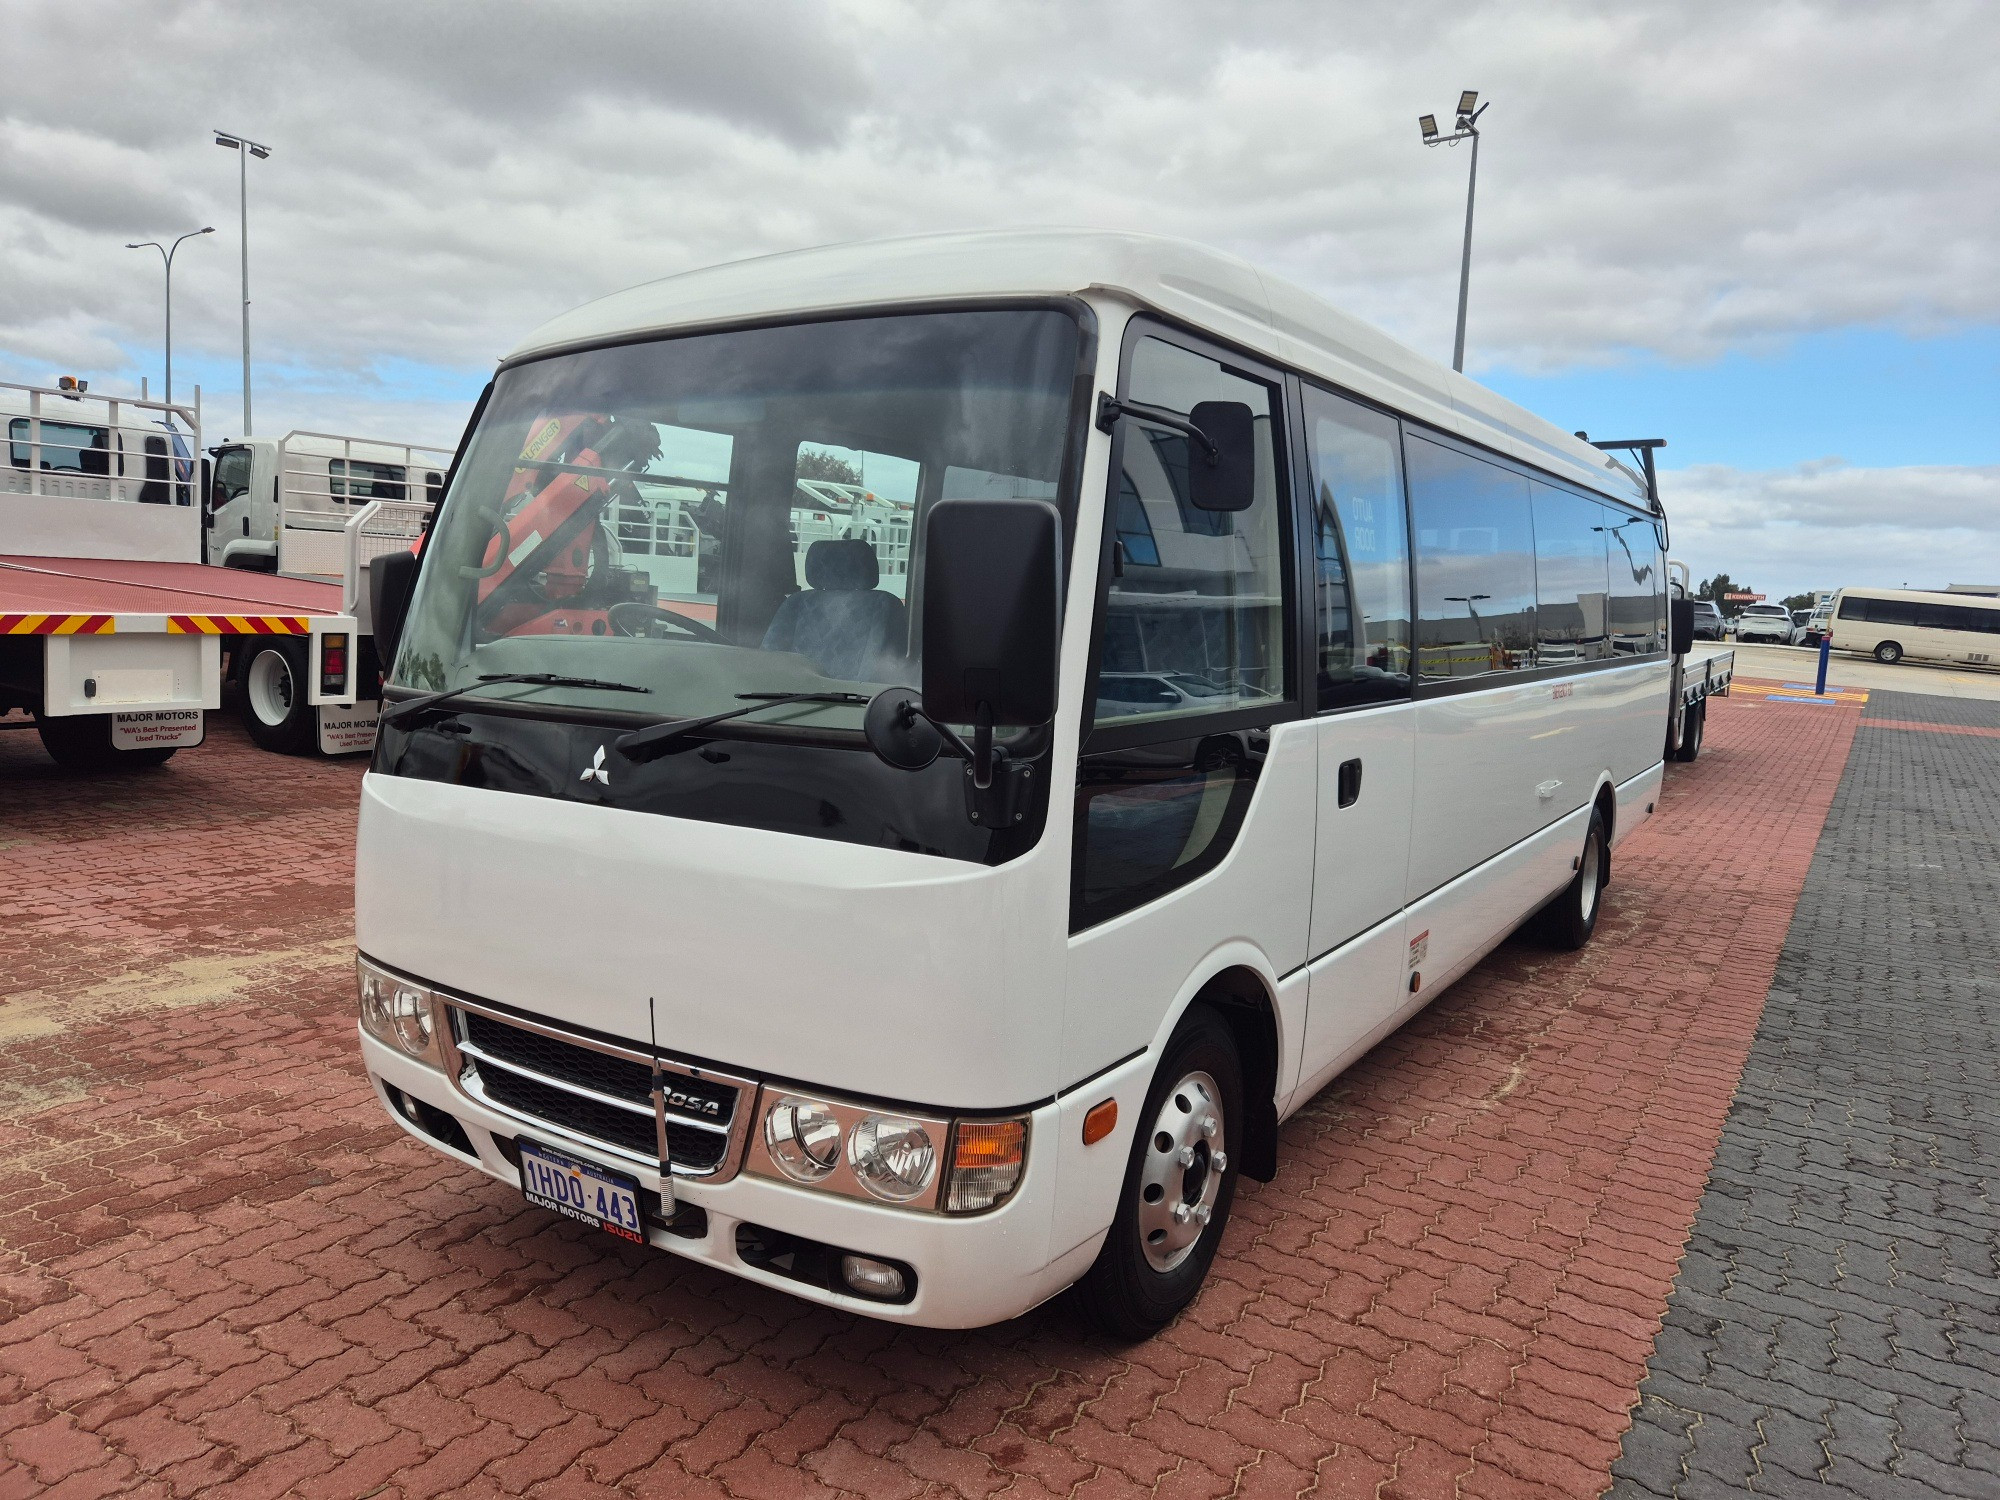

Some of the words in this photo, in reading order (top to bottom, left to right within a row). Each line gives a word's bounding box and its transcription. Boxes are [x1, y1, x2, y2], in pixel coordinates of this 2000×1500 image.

[117, 713, 153, 722] MAJOR
[156, 711, 198, 720] MOTORS
[160, 724, 196, 732] Presented
[324, 722, 352, 730] MAJOR
[538, 1152, 564, 1166] WESTERN
[586, 1169, 615, 1184] AUSTRALIA
[526, 1192, 558, 1212] MAJOR
[560, 1205, 600, 1227] MOTORS
[603, 1222, 643, 1244] ISUZU
